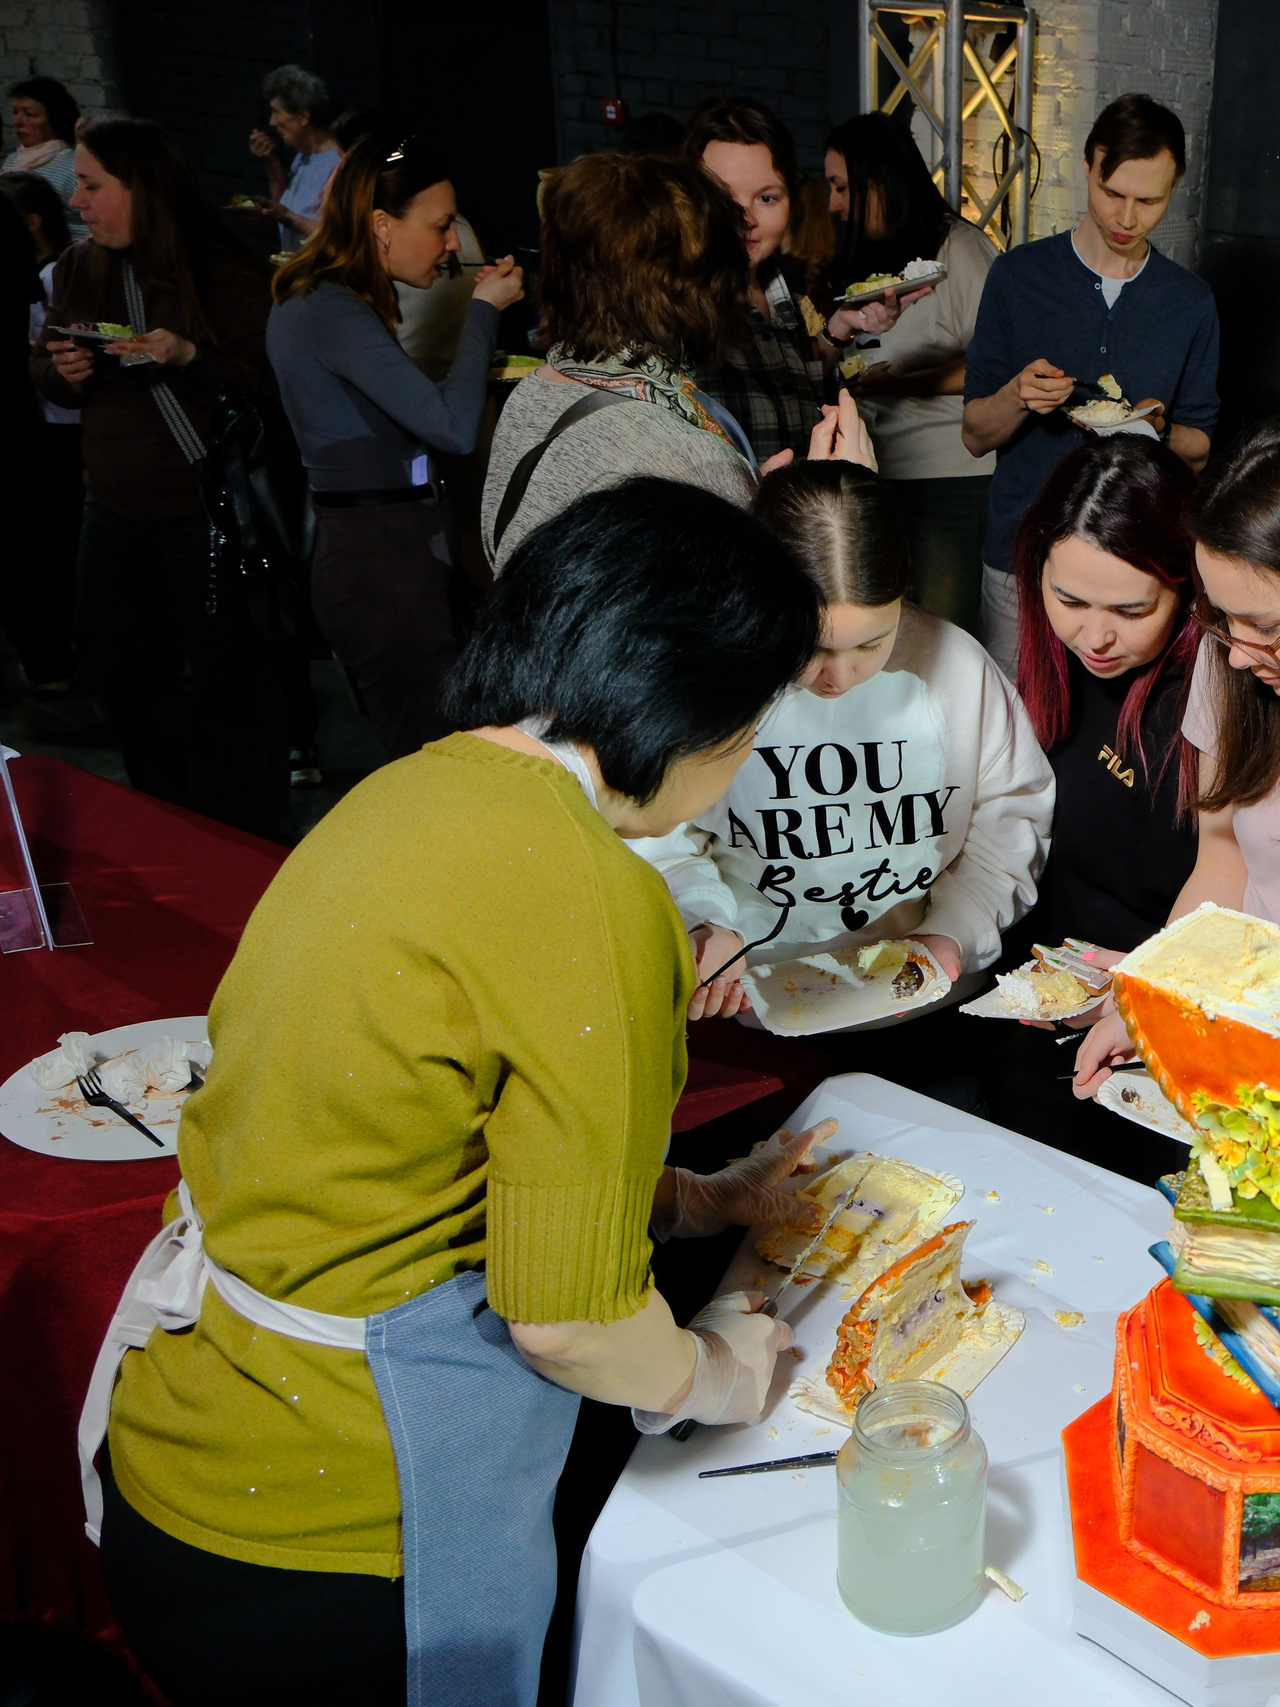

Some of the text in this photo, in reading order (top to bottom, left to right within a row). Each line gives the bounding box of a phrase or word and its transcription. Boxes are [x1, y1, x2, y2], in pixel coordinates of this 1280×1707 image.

[752, 739, 908, 800] YOU
[1097, 744, 1135, 788] FILA
[727, 785, 961, 861] ARE MY
[750, 857, 940, 908] Bestie
